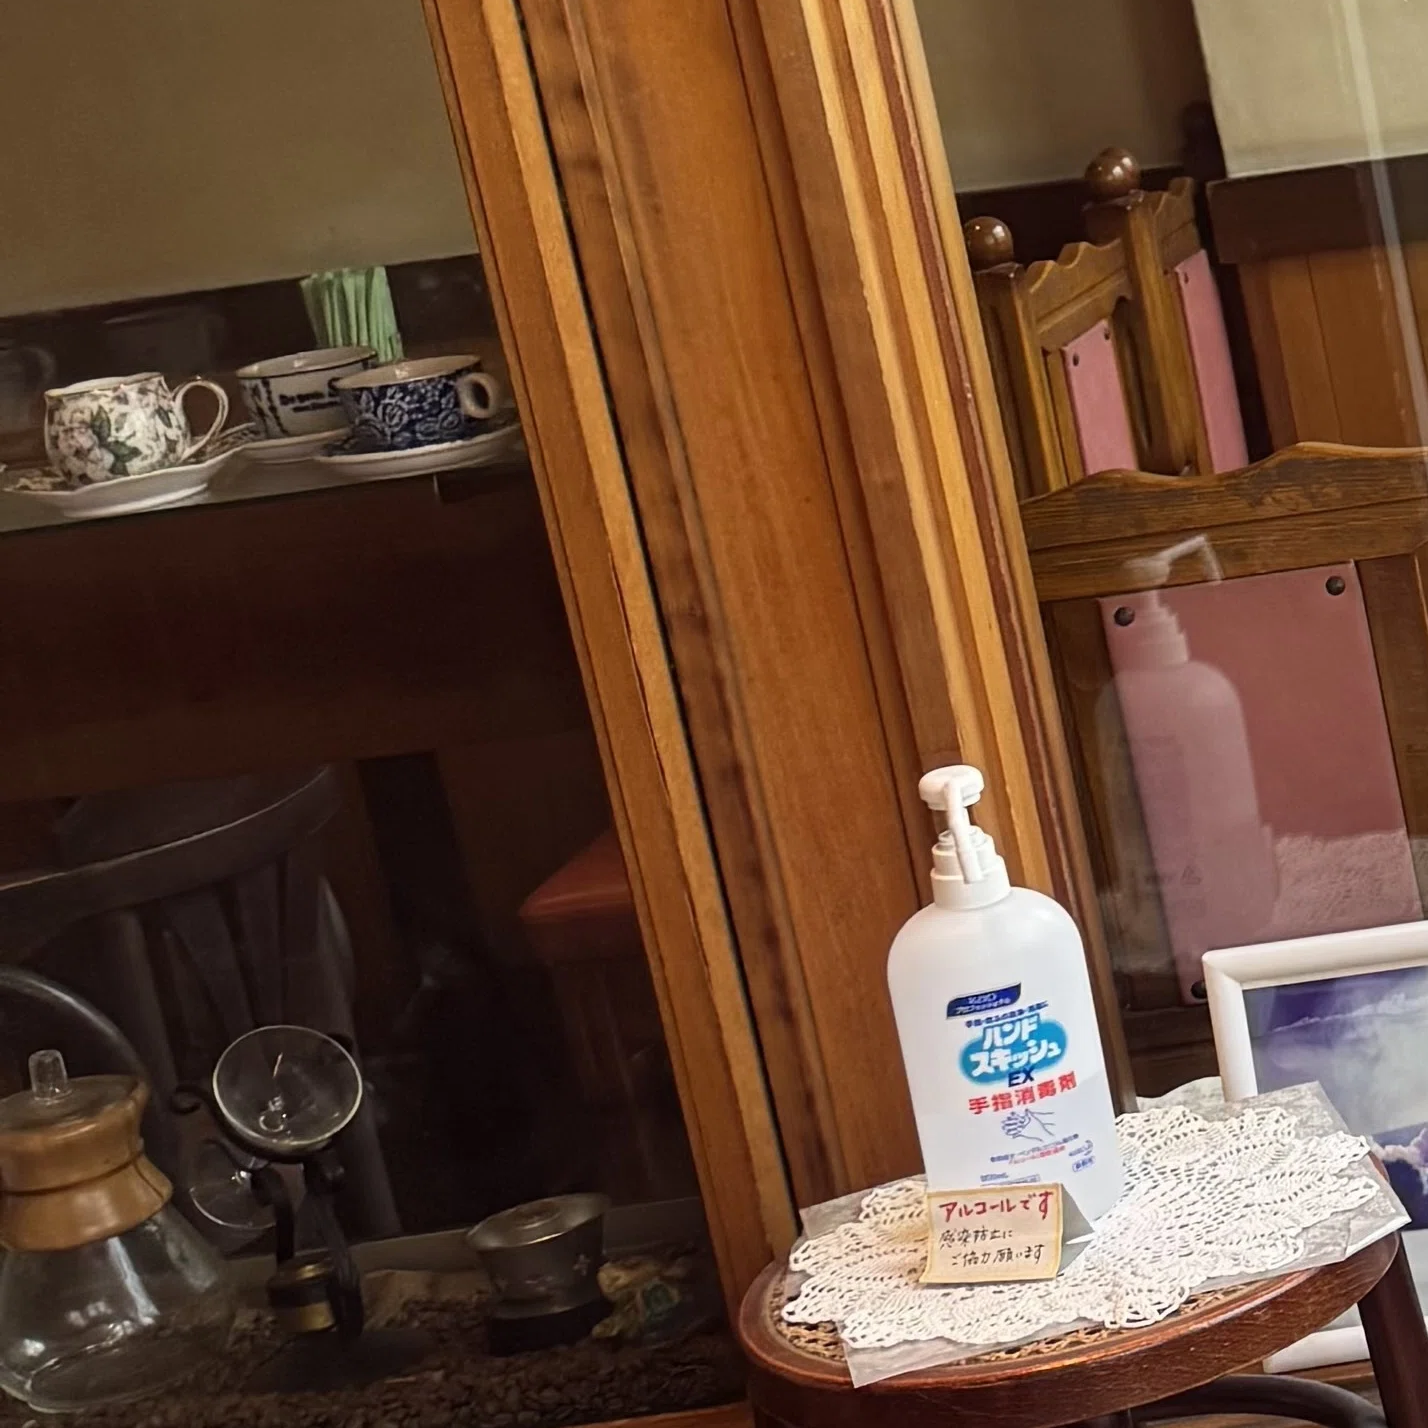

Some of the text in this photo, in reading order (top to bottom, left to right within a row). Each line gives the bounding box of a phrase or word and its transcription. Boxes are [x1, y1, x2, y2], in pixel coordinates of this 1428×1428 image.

[983, 1013, 1040, 1050] ハンド
[969, 1038, 1062, 1077] スキッシュ
[968, 1071, 1077, 1115] 手指消毒剤
[1008, 1066, 1035, 1088] EX
[939, 1190, 1053, 1222] アルコールです
